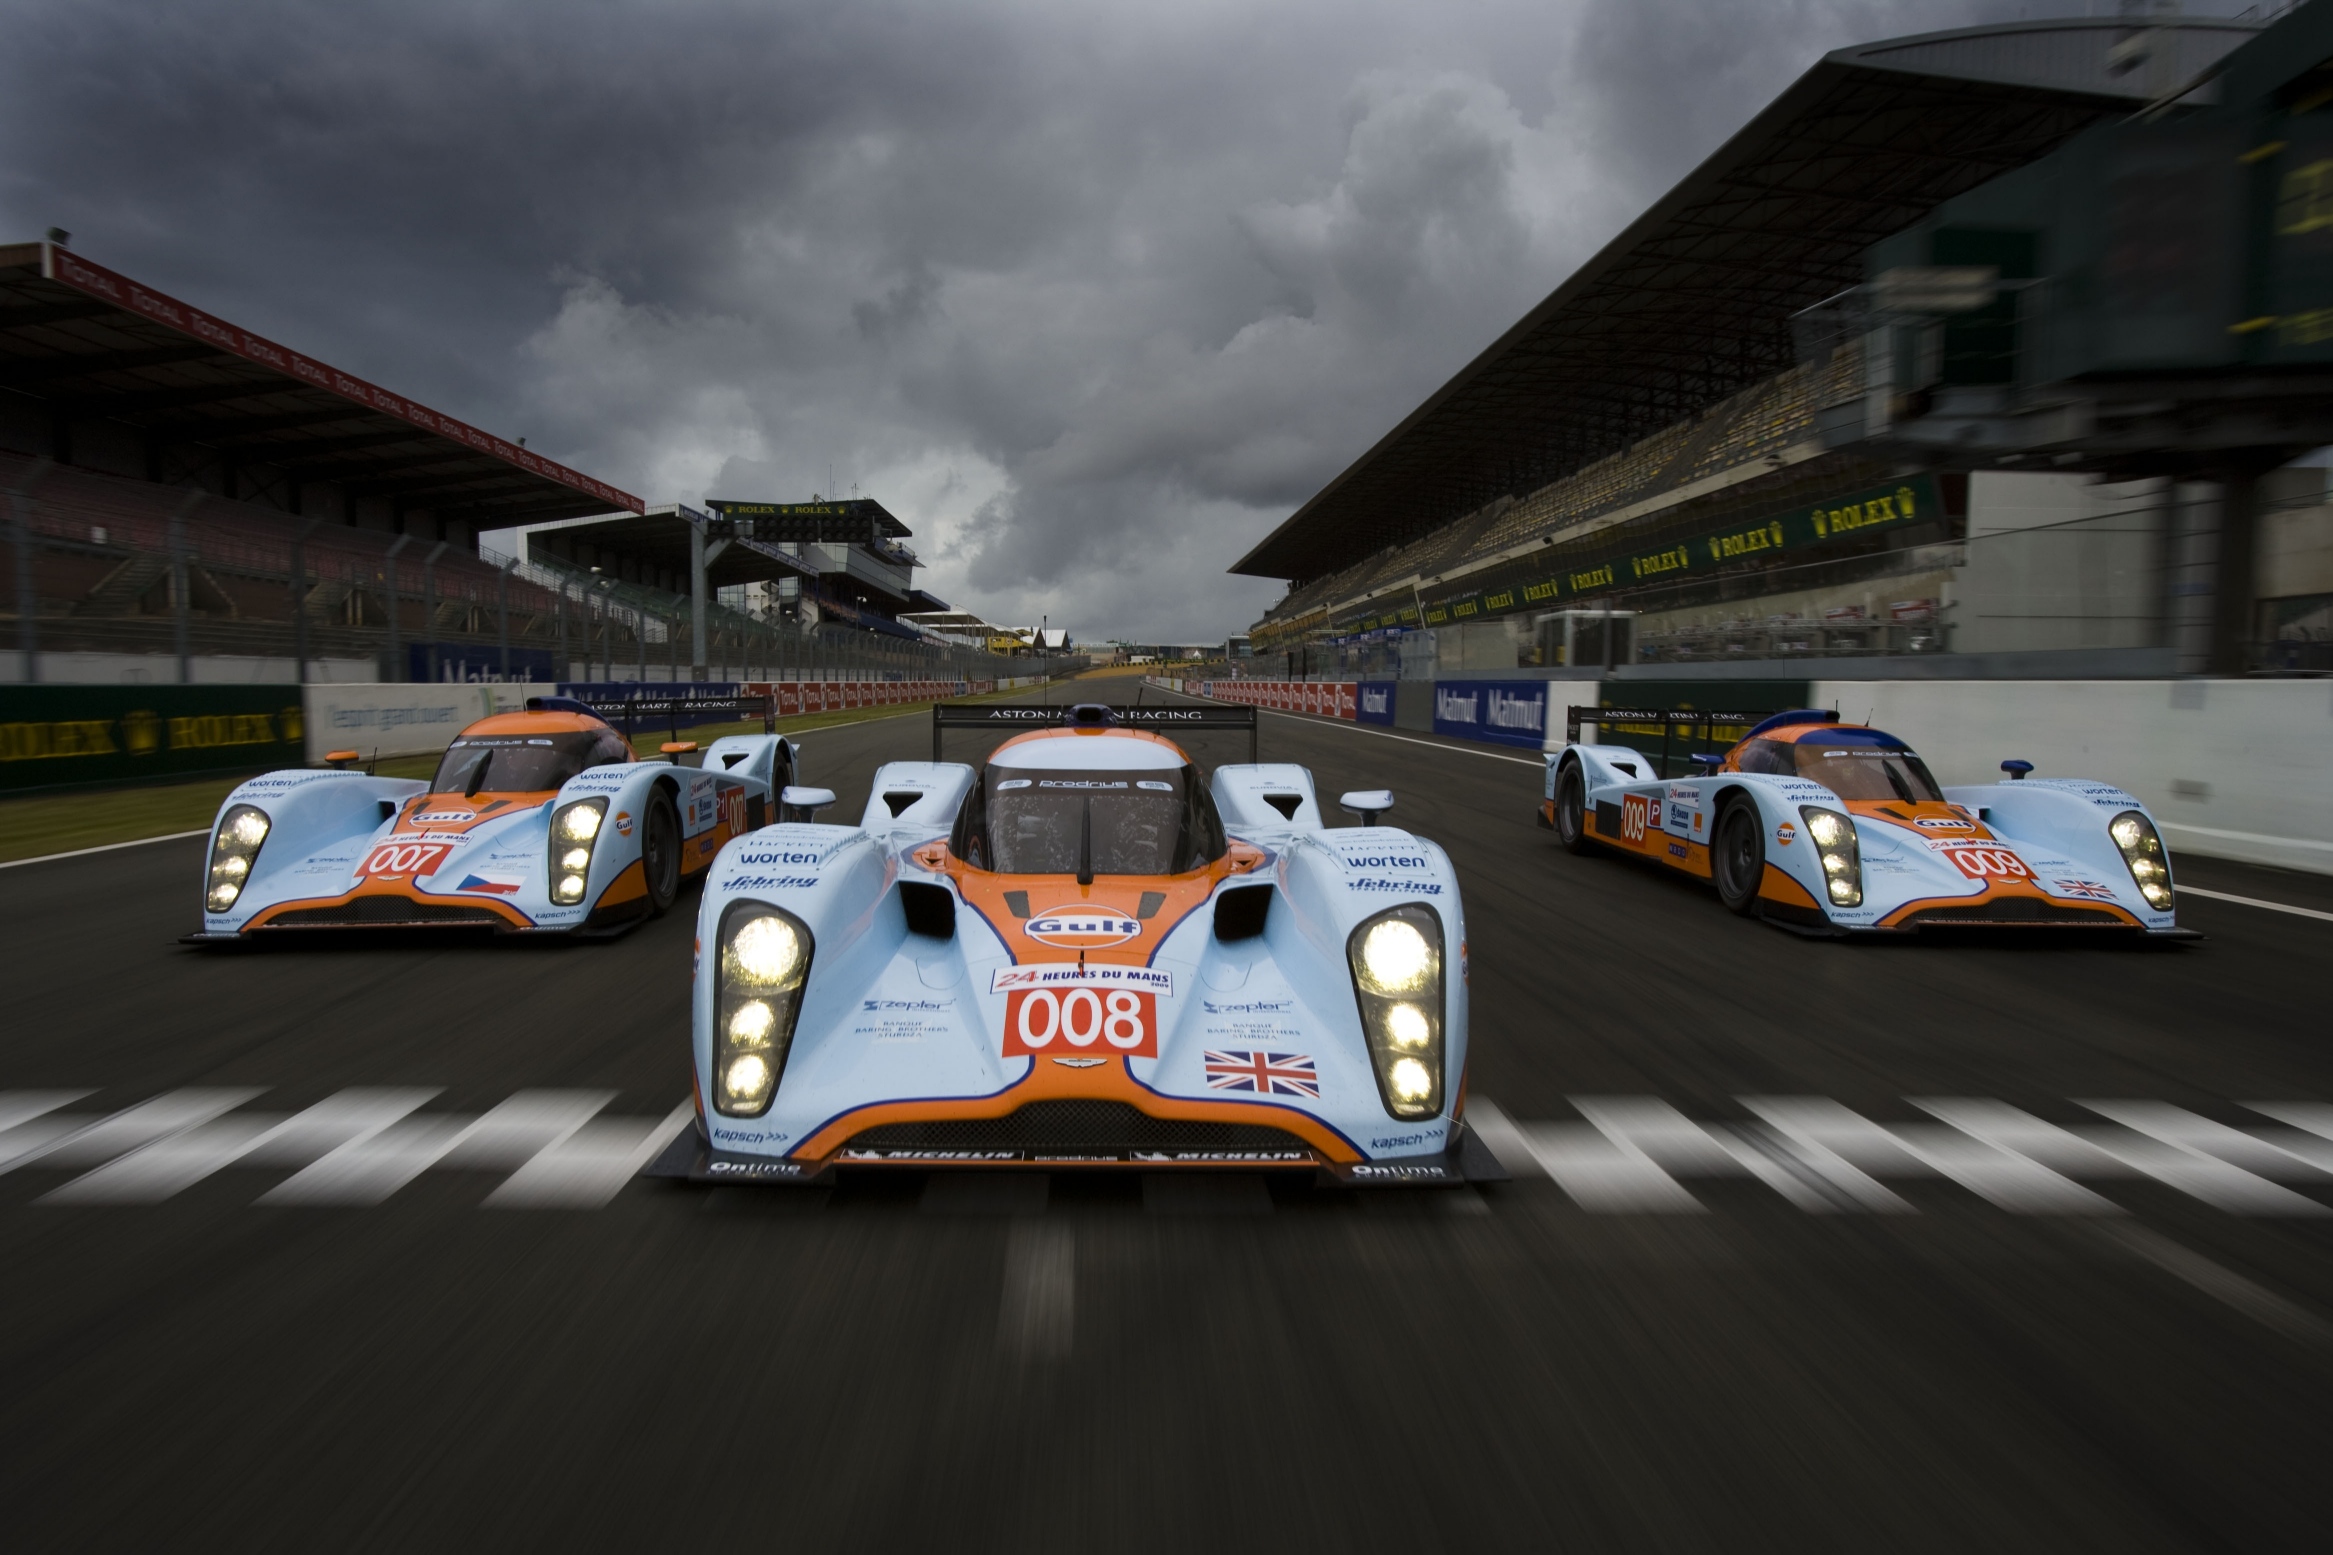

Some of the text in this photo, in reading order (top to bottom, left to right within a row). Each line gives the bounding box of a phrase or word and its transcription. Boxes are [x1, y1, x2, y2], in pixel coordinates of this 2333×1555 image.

[127, 285, 183, 325] TOTAL
[189, 312, 238, 348] TOTAL
[242, 335, 286, 366] TOTAL
[290, 355, 330, 385] TOTAL
[334, 373, 368, 400] TOTAL
[371, 389, 403, 414] TOTAL
[406, 404, 435, 427] TOTAL
[439, 417, 464, 439] TOTAL
[466, 430, 491, 449] TOTAL
[493, 440, 515, 459] TOTAL
[518, 451, 538, 468] TOTAL
[738, 506, 831, 514] ROLEX ROLEX
[1529, 583, 1553, 600] ROLEX
[1577, 569, 1606, 589] ROLEX
[1640, 551, 1679, 574] ROLEX
[1720, 528, 1770, 556] ROLEX
[1829, 497, 1896, 532] ROLEX
[780, 690, 798, 706] TOTAL
[805, 689, 821, 704] TOTAL
[685, 701, 737, 709] RACING
[1486, 689, 1543, 731] Matmut
[990, 710, 1050, 719] ASTON
[1131, 711, 1203, 719] RACING
[1605, 711, 1645, 719] ASTON
[412, 813, 474, 821] Gulf
[730, 793, 744, 836] 007
[616, 819, 632, 830] Gulf
[1624, 800, 1645, 842] 009
[1917, 818, 1974, 828] Gulf
[1777, 829, 1796, 839] Gulf
[1930, 841, 1950, 849] 24
[368, 845, 444, 873] 007
[741, 852, 818, 864] worten
[1347, 856, 1425, 867] worten
[1955, 850, 2027, 876] 009
[534, 911, 566, 919] kapsch
[1030, 919, 1140, 934] Gulf
[995, 970, 1169, 988] 24 HEURES DU MANS
[885, 1000, 945, 1011] zepler
[1224, 1001, 1285, 1013] zepler
[1018, 988, 1144, 1049] 008
[714, 1128, 764, 1143] kapsch
[1371, 1133, 1423, 1149] kapsch
[888, 1151, 1014, 1159] MICHELIN
[1177, 1152, 1301, 1160] MICHELIN
